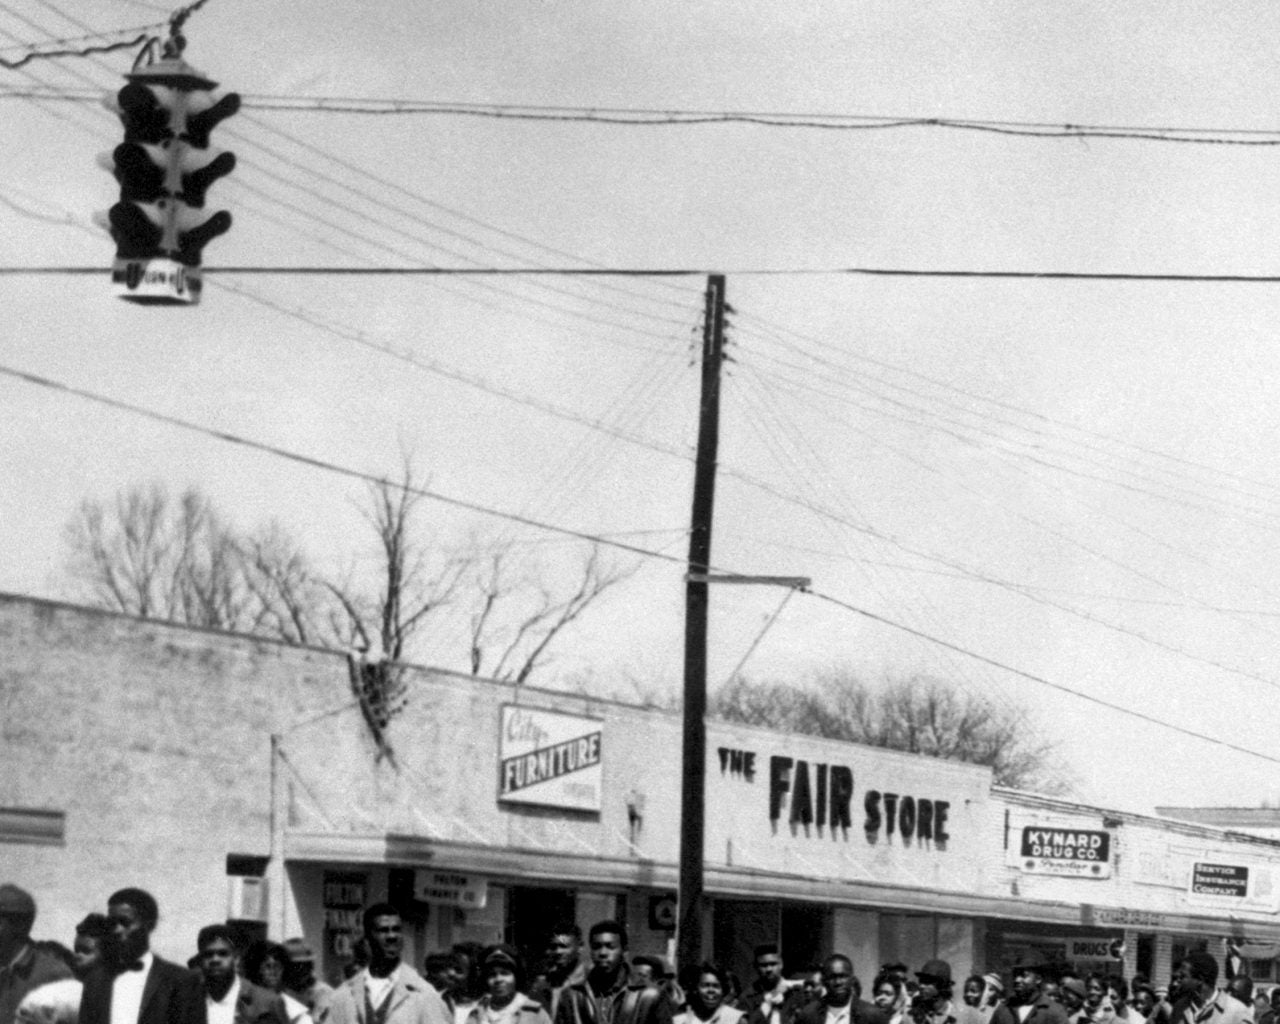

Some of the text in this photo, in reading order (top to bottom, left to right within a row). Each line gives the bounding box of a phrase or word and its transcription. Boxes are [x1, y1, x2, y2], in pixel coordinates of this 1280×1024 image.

[504, 733, 600, 794] FURNITURE
[717, 746, 950, 848] THE FAIR STORE
[1028, 830, 1102, 849] KYNARD
[1032, 845, 1101, 860] DRUG CO.
[1073, 942, 1108, 956] DRUGS
